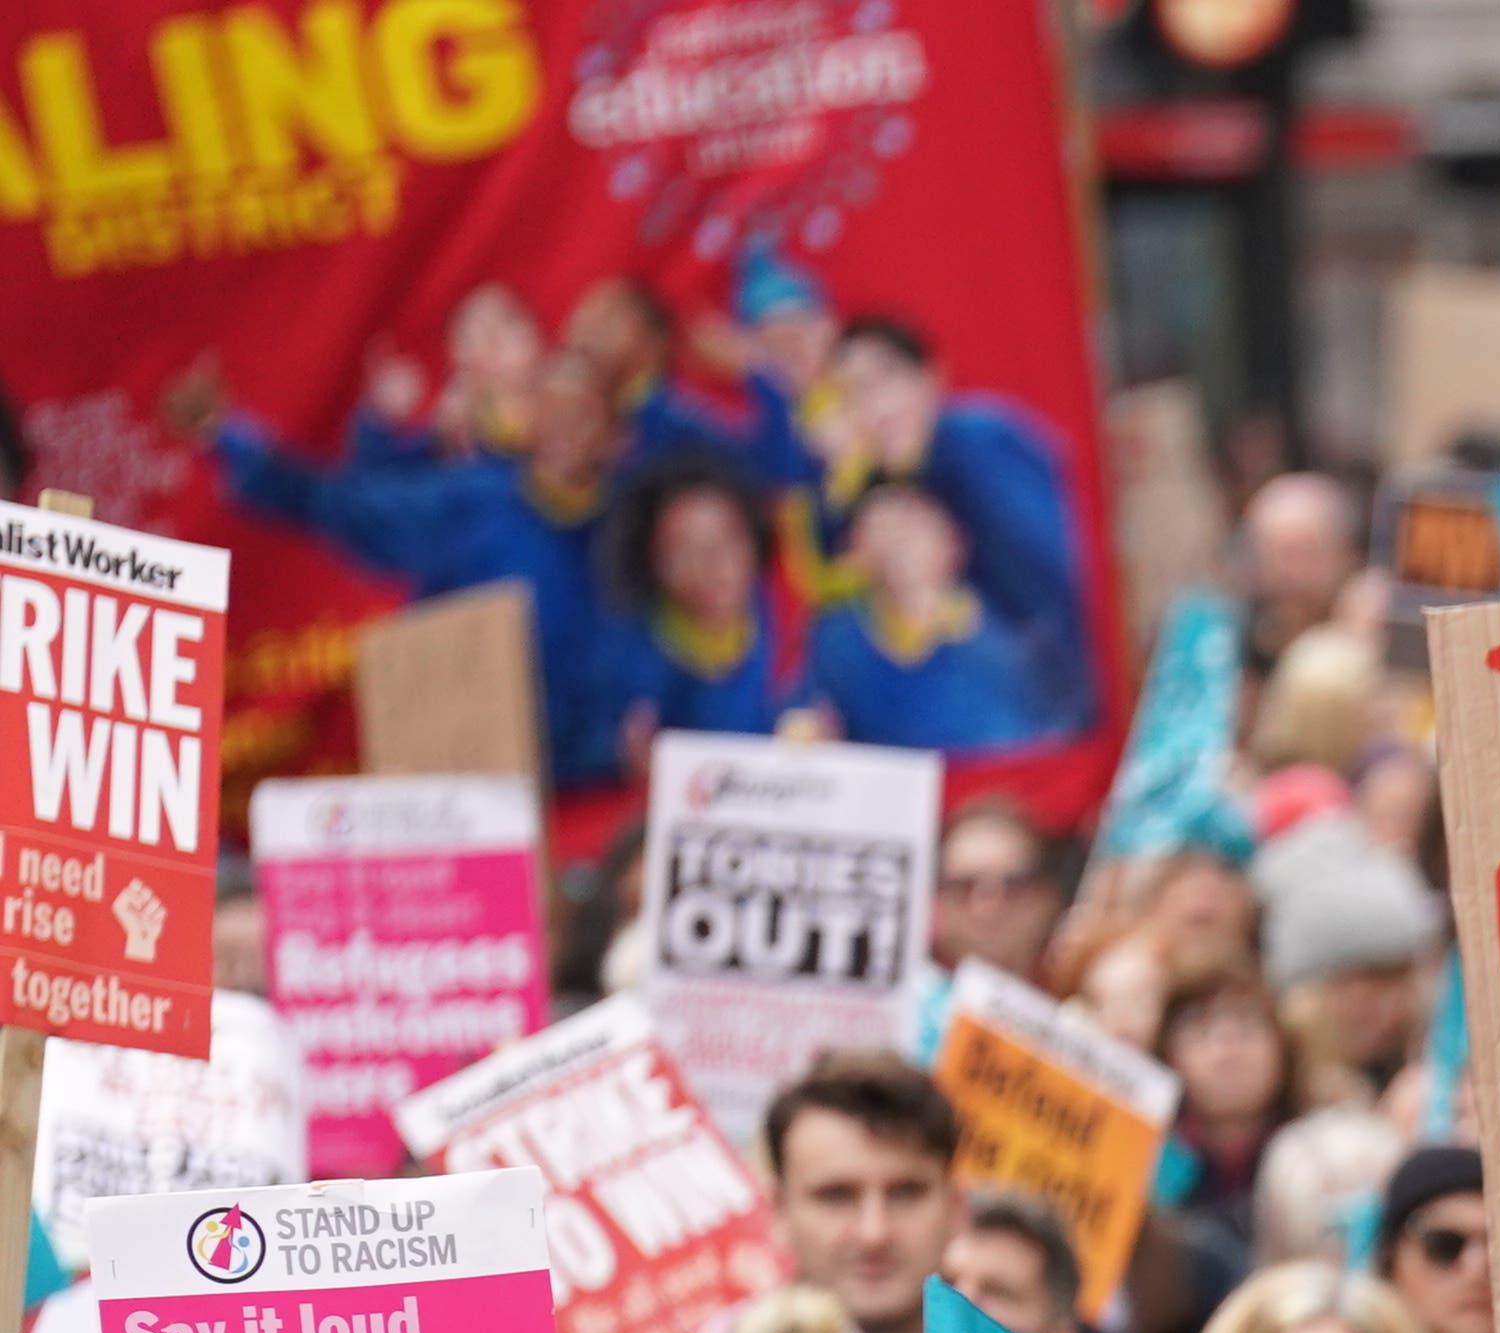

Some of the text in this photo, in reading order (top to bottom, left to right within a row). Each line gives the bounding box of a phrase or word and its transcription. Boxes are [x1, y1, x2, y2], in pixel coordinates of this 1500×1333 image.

[0, 519, 184, 592] list Worker
[0, 572, 203, 731] RIKE
[26, 701, 200, 854] WIN
[18, 845, 105, 901] need
[3, 888, 75, 945] rise
[669, 892, 901, 982] OUT!
[11, 957, 173, 1034] together
[275, 1201, 436, 1241] STAND UP
[279, 1233, 458, 1277] TO RACISM
